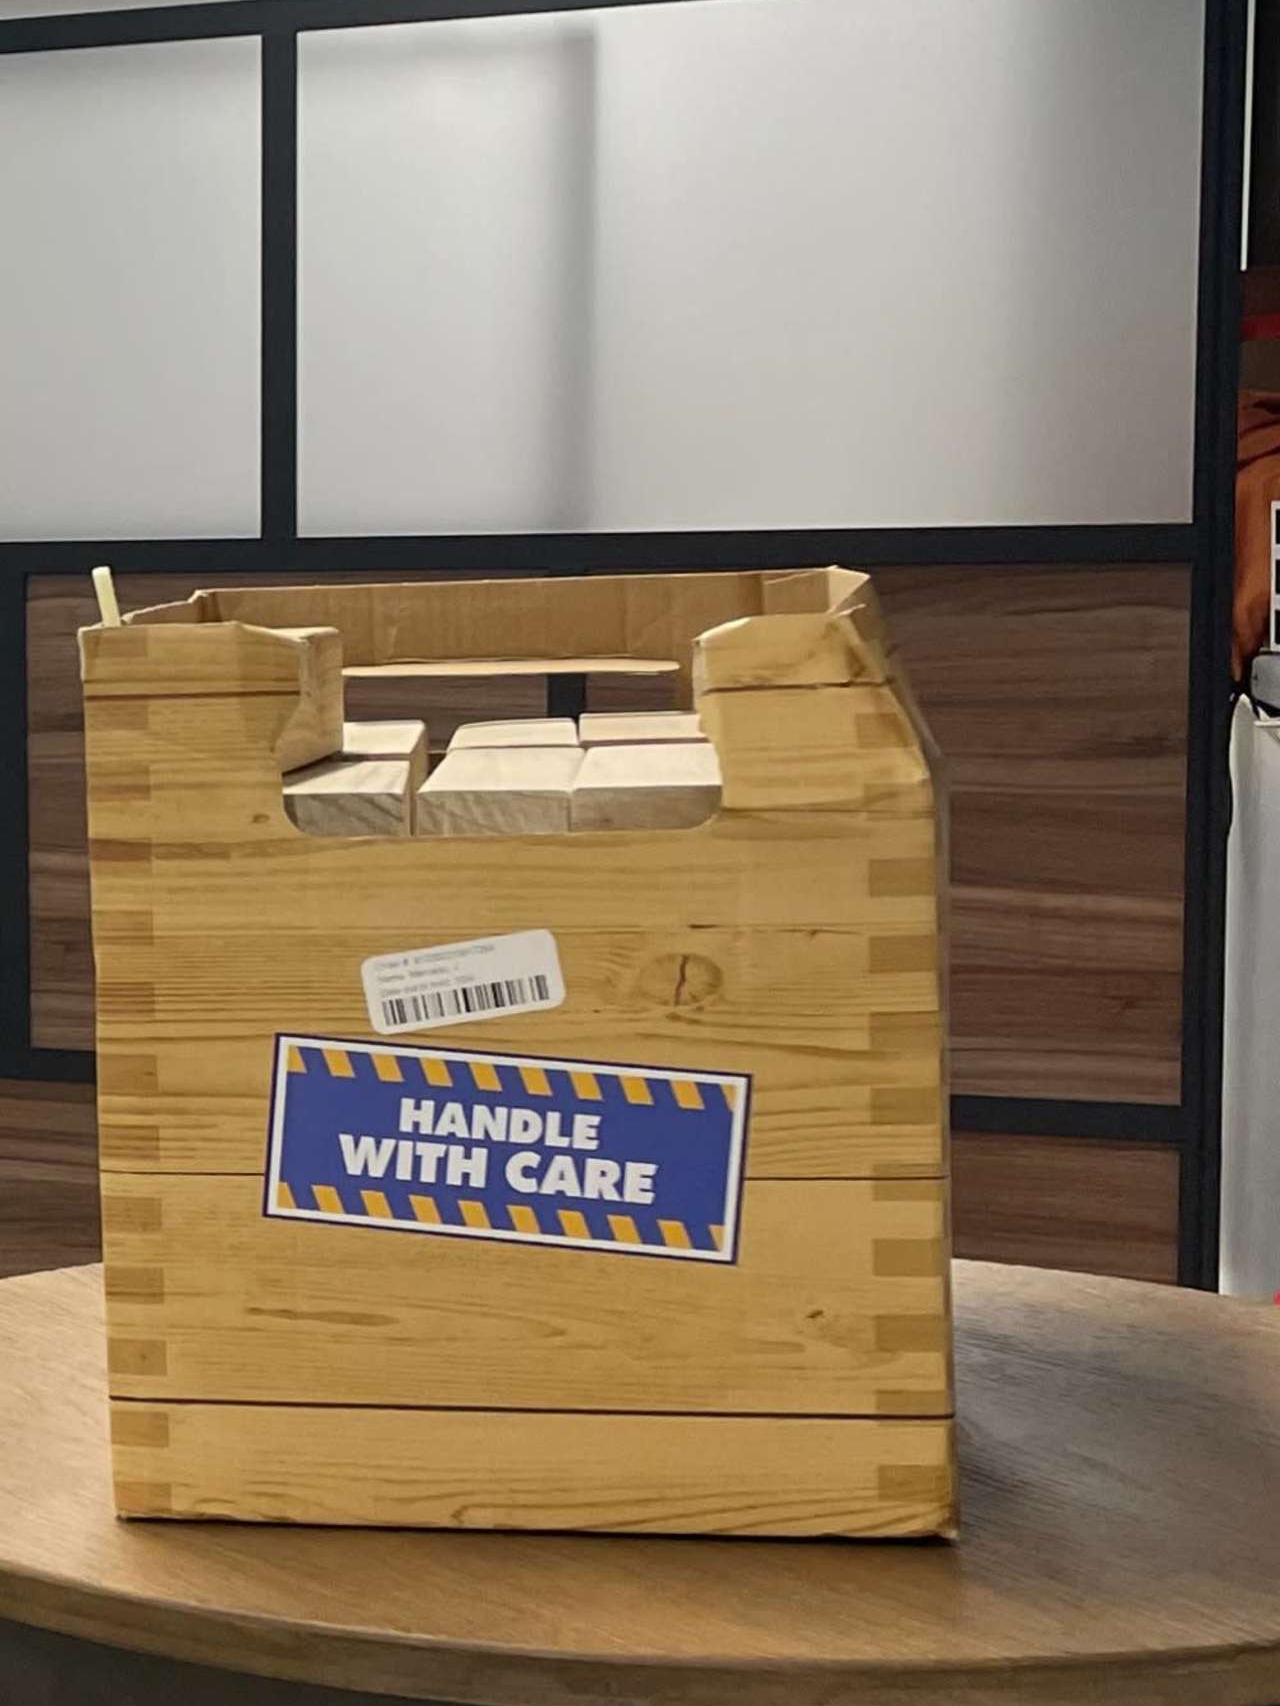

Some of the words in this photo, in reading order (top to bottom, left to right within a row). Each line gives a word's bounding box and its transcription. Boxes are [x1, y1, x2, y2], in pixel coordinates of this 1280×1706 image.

[398, 1097, 602, 1151] HANDLE
[338, 1133, 489, 1189] WITH
[504, 1151, 659, 1205] CARE
